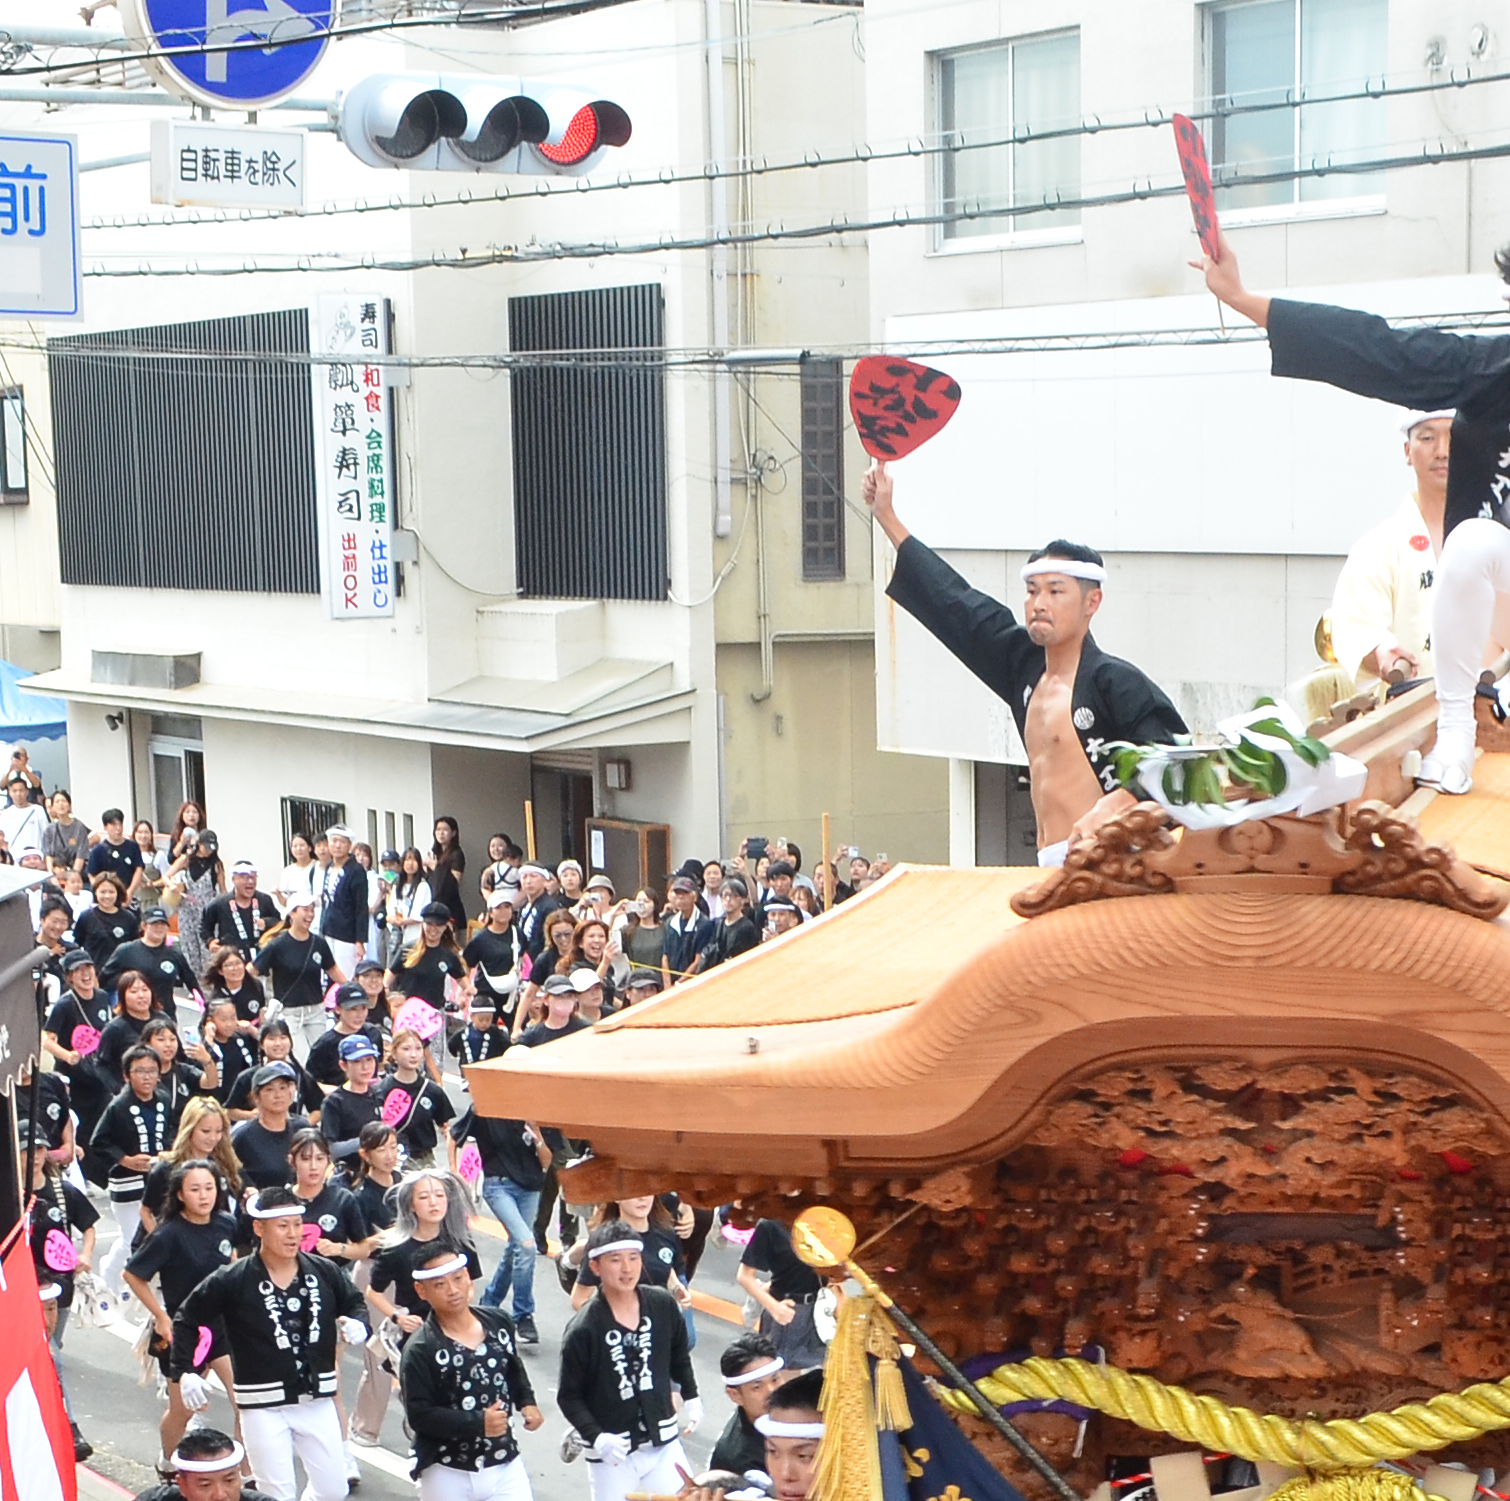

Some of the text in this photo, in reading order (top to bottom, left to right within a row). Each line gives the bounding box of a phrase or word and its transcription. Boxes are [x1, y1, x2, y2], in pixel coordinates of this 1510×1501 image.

[179, 145, 297, 188] 自転車を除く
[359, 302, 389, 608] 寿司 和食・会席料理・仕出し
[341, 531, 359, 610] 出前OK
